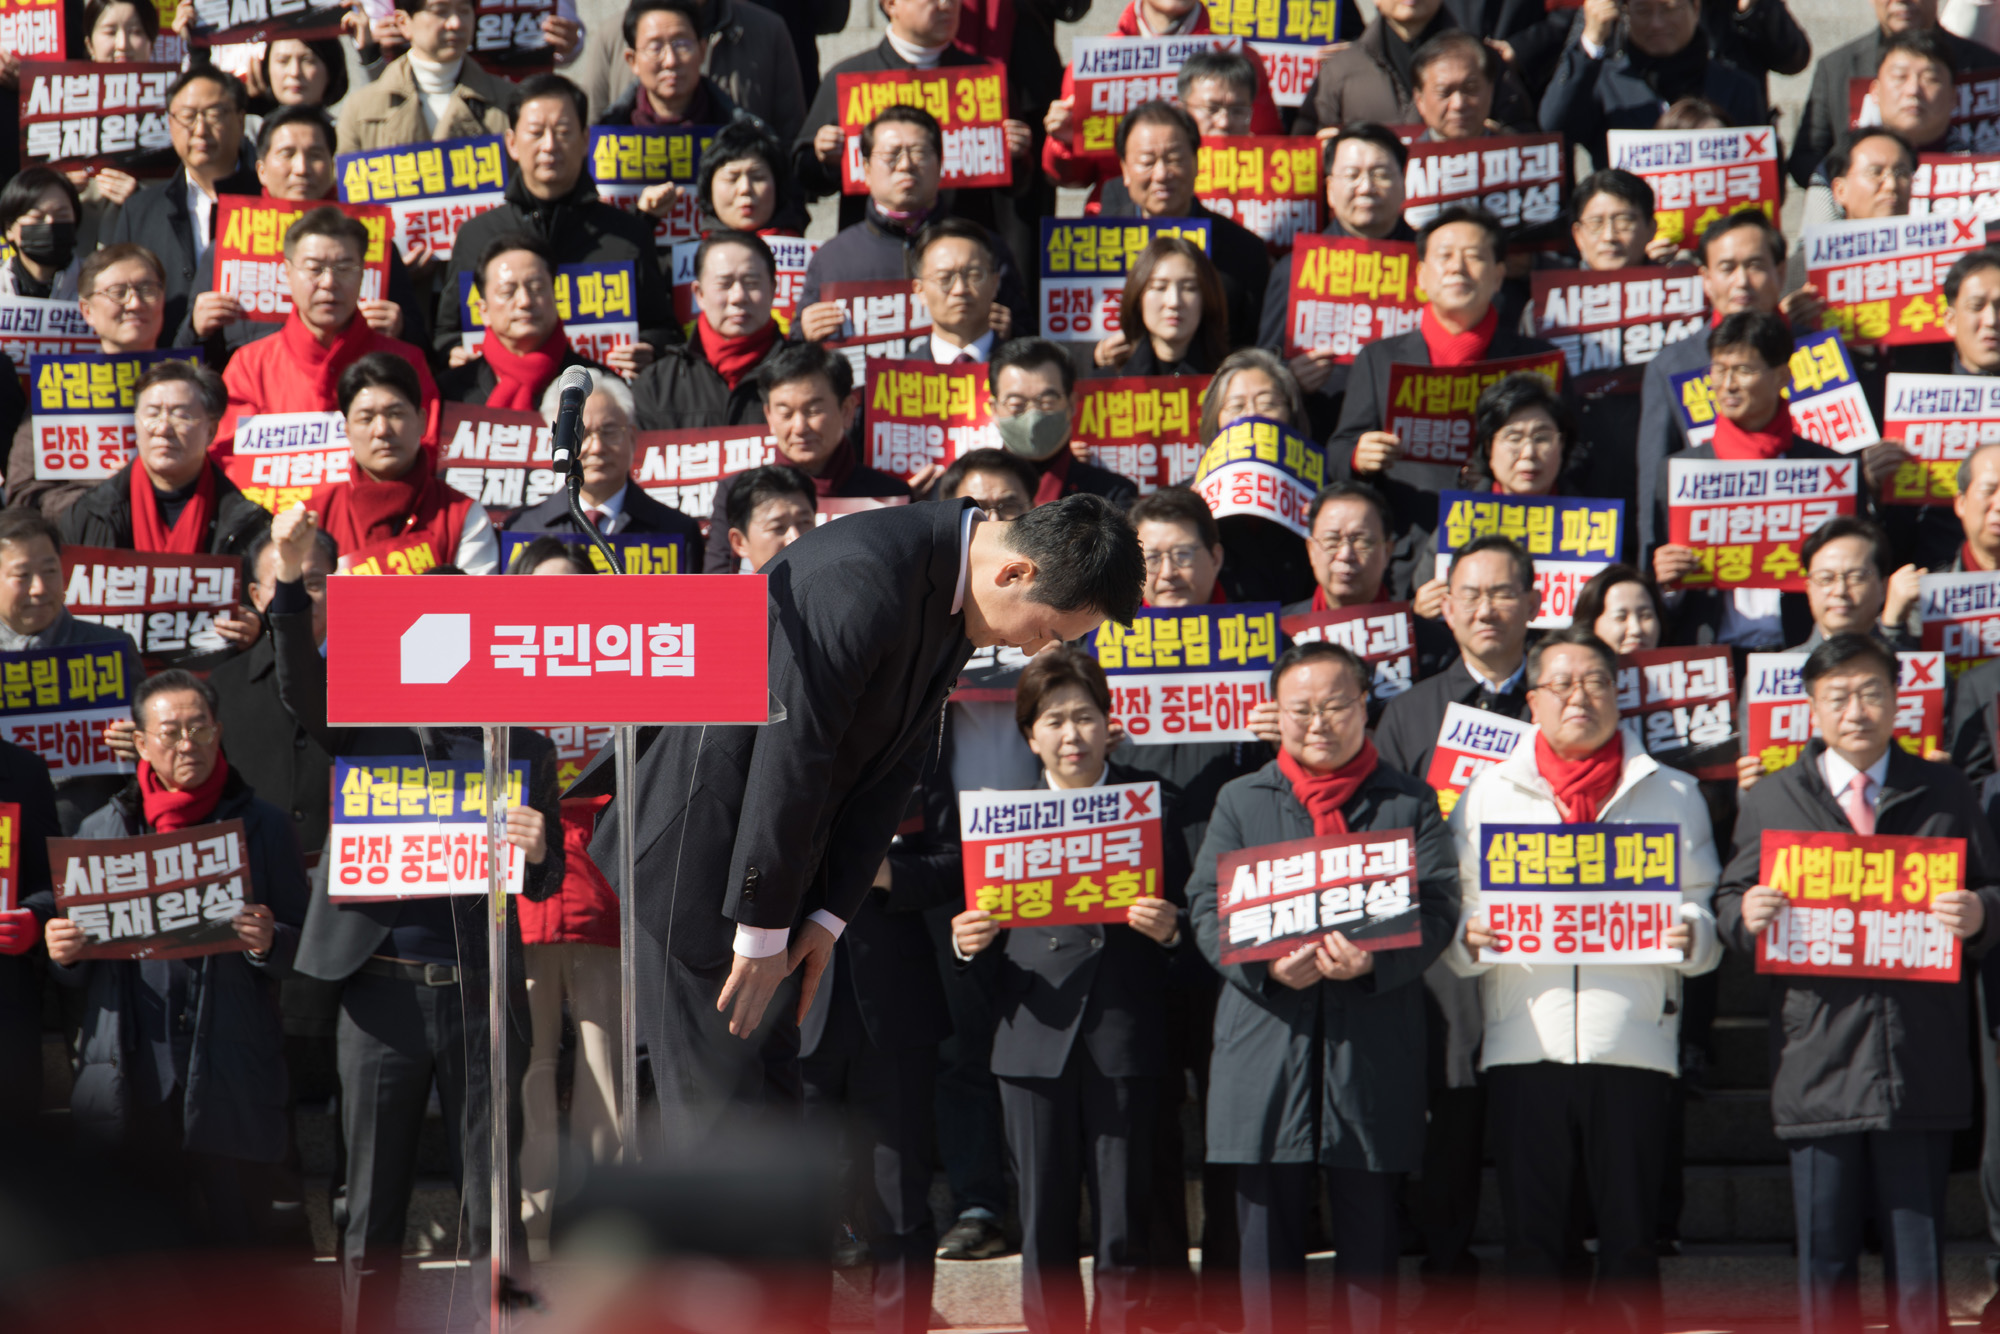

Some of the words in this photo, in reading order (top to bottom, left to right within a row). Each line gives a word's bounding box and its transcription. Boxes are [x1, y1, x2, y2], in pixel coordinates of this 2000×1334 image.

[1079, 46, 1161, 74] 사법파괴
[27, 73, 99, 116] 사법
[956, 75, 1002, 123] 3법
[27, 118, 98, 159] 독재
[593, 134, 693, 180] 삼권분립
[941, 126, 1005, 178] 부하라!
[1617, 141, 1692, 168] 사법파괴
[1698, 135, 1739, 160] 악법
[343, 148, 446, 203] 삼권분립
[449, 142, 505, 191] 파괴
[1270, 147, 1318, 195] 3법
[1405, 152, 1479, 200] 사법
[1482, 142, 1560, 188] 파괴
[1652, 165, 1762, 210] 한민국
[1813, 226, 1898, 262] 사법파괴
[1905, 219, 1947, 246] 악법
[577, 270, 631, 318] 파괴
[1298, 247, 1410, 302] 사법파괴
[1048, 288, 1093, 333] 당장
[1293, 299, 1373, 356] 대통령은
[1543, 283, 1622, 330] 사법
[1625, 274, 1705, 319] 파괴
[1550, 329, 1622, 378] 독재
[1789, 336, 1850, 392] 파괴
[37, 360, 141, 409] 삼권분립
[872, 369, 977, 421] 사법파괴
[1894, 387, 1984, 414] 사법파괴
[241, 422, 330, 450] 사법파괴
[1078, 387, 1190, 438] 사법파괴
[41, 425, 90, 470] 당장
[449, 420, 533, 462] 사법
[640, 443, 720, 481] 사법
[872, 421, 945, 474] 대통령은
[1284, 434, 1325, 489] 파괴
[1393, 416, 1471, 462] 대통령은
[1677, 470, 1768, 501] 사법파괴
[1774, 466, 1818, 494] 악법
[1561, 506, 1618, 558] 파괴
[65, 563, 149, 608] 사법
[152, 566, 237, 607] 파괴
[1927, 581, 2000, 617] 사법파
[490, 622, 695, 677] 국민의힘
[1094, 614, 1211, 668] 삼권분립
[1218, 612, 1276, 665] 파괴
[1325, 612, 1412, 657] 파괴
[0, 655, 61, 710] 분립
[67, 650, 126, 704] 파괴
[1645, 656, 1731, 704] 파괴
[1647, 699, 1733, 752] 완성
[340, 765, 455, 818] 삼권분립
[968, 801, 1065, 834] 사법파괴
[1072, 792, 1120, 823] 악법
[63, 851, 149, 898] 사법
[152, 832, 243, 887] 파괴
[339, 835, 392, 886] 당장
[984, 828, 1143, 882] 대한민국
[1225, 851, 1316, 908] 사법
[1320, 838, 1411, 884] 파괴
[1486, 832, 1607, 885] 삼권분립
[1613, 832, 1675, 885] 파괴
[1768, 844, 1896, 904] 사법파괴
[1901, 850, 1959, 904] 3법
[67, 897, 157, 945] 독재
[156, 875, 246, 934] 완성
[975, 880, 1053, 922] 헌정
[1064, 868, 1157, 914] 수호!
[1228, 893, 1319, 947] 독재
[1319, 875, 1413, 929] 완성
[1488, 902, 1543, 954] 당장
[1553, 901, 1673, 954] 중단하라!
[1764, 906, 1854, 967] 대통령은
[1858, 908, 1955, 970] 거부하라!
